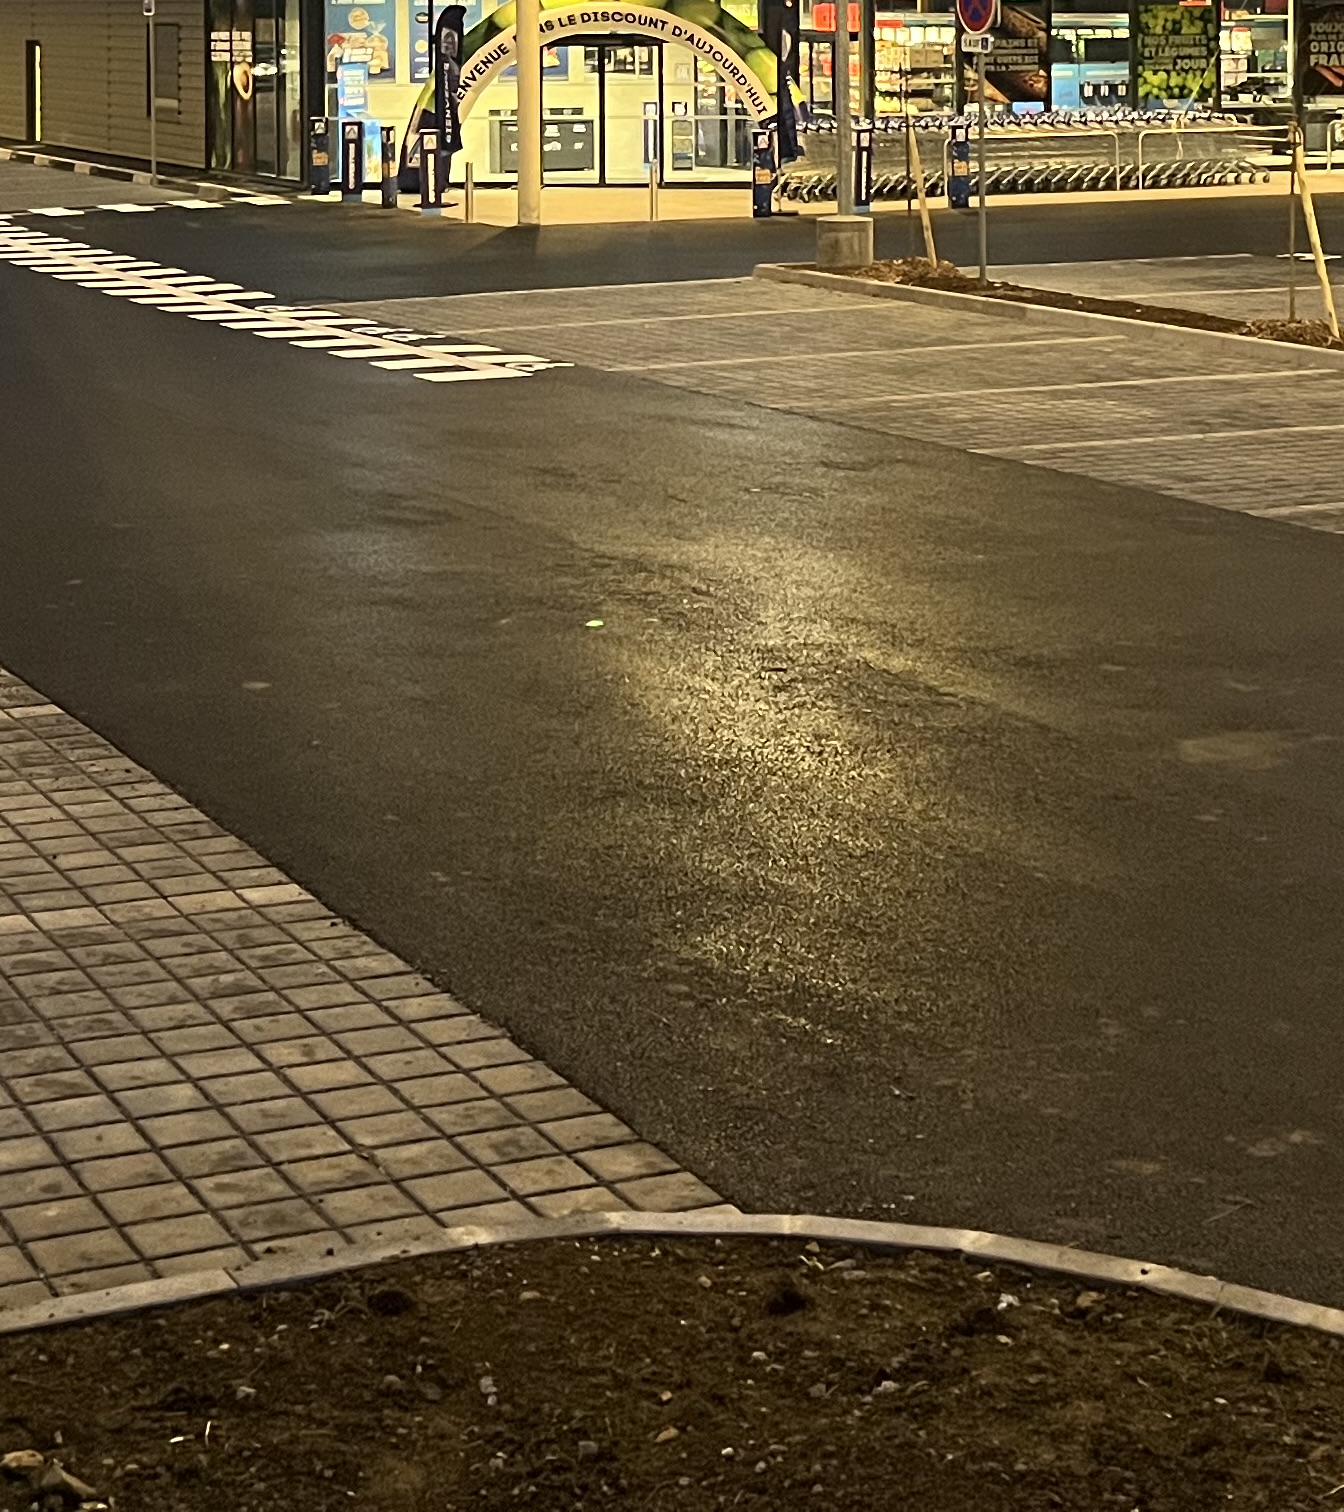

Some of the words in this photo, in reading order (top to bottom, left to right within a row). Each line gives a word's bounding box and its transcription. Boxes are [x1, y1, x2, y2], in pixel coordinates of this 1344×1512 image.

[457, 42, 510, 101] ENVENUE
[557, 13, 577, 28] LE
[580, 11, 669, 32] DISCOUNT
[671, 25, 768, 116] D'AUJOURD'HUI
[1175, 58, 1208, 70] JOUR
